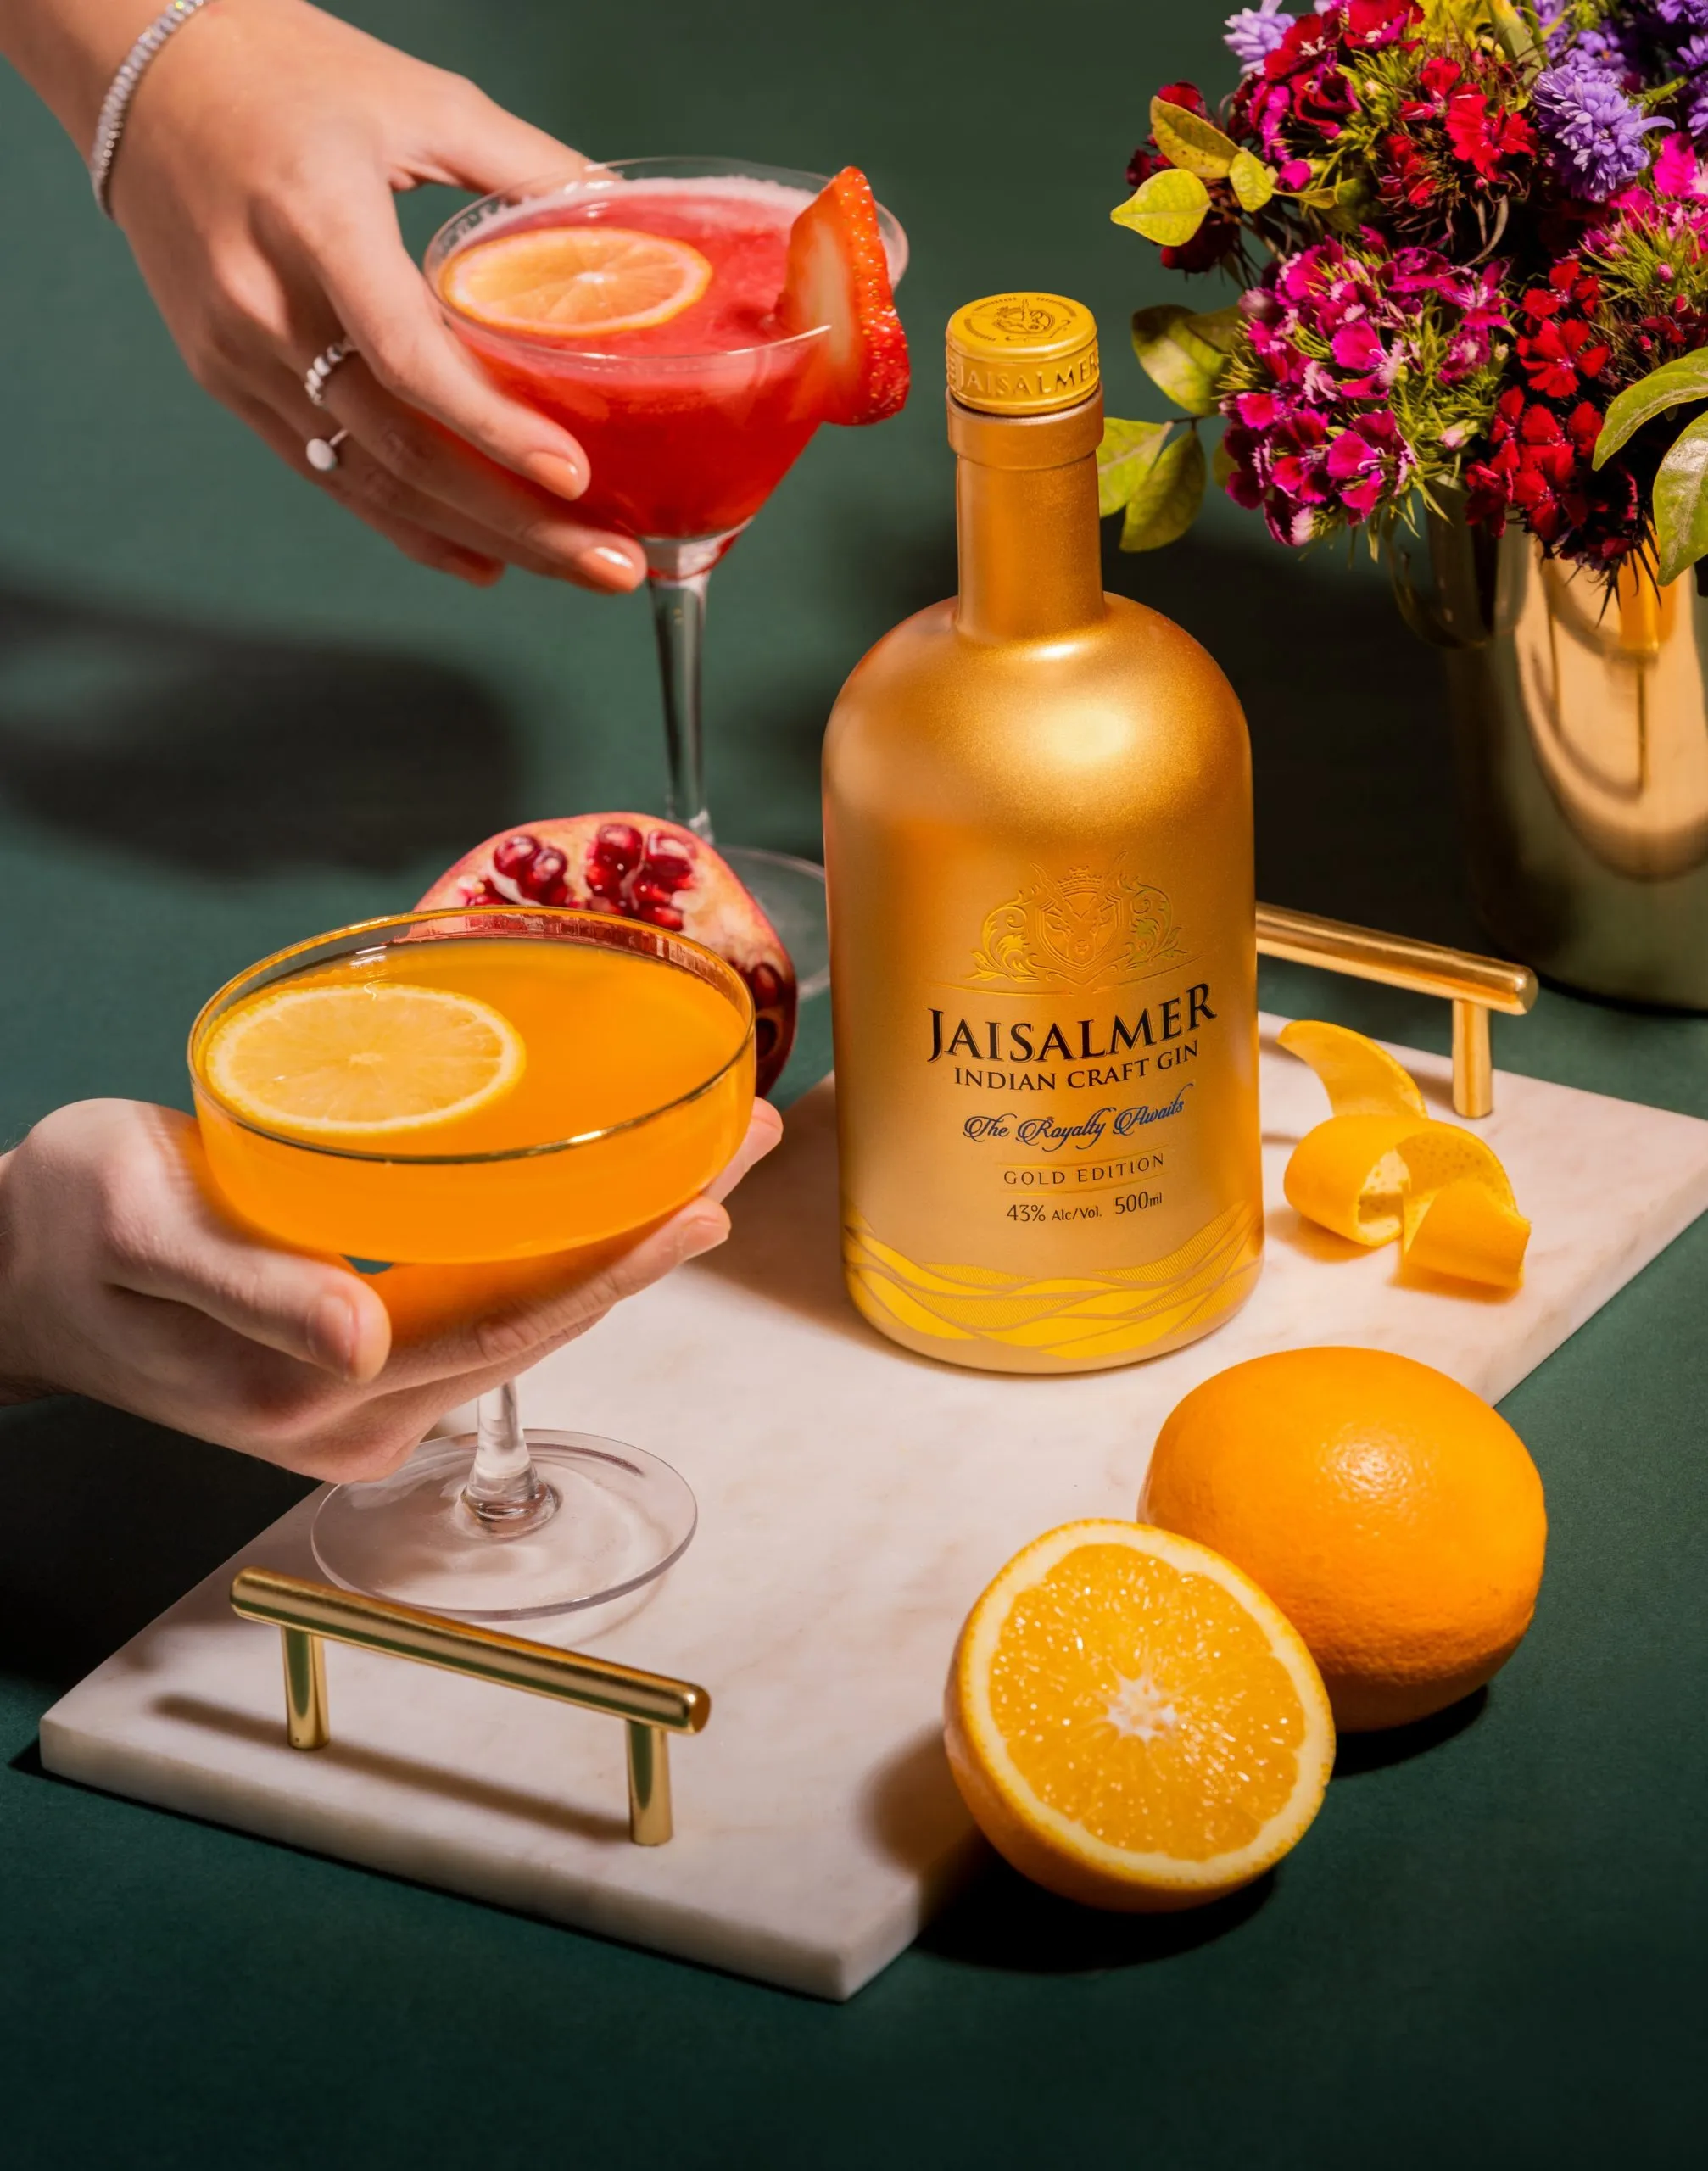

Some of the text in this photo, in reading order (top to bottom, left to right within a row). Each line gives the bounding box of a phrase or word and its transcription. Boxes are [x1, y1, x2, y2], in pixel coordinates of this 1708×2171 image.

[927, 983, 1218, 1063] JAISALMER
[954, 1040, 1198, 1091] INDIAN CRAFT GIN
[963, 1083, 1194, 1152] The Royalty Awaits
[1003, 1153, 1164, 1186] GOLD EDITION
[1007, 1191, 1164, 1223] 43% Alc/Vol. 500ml
